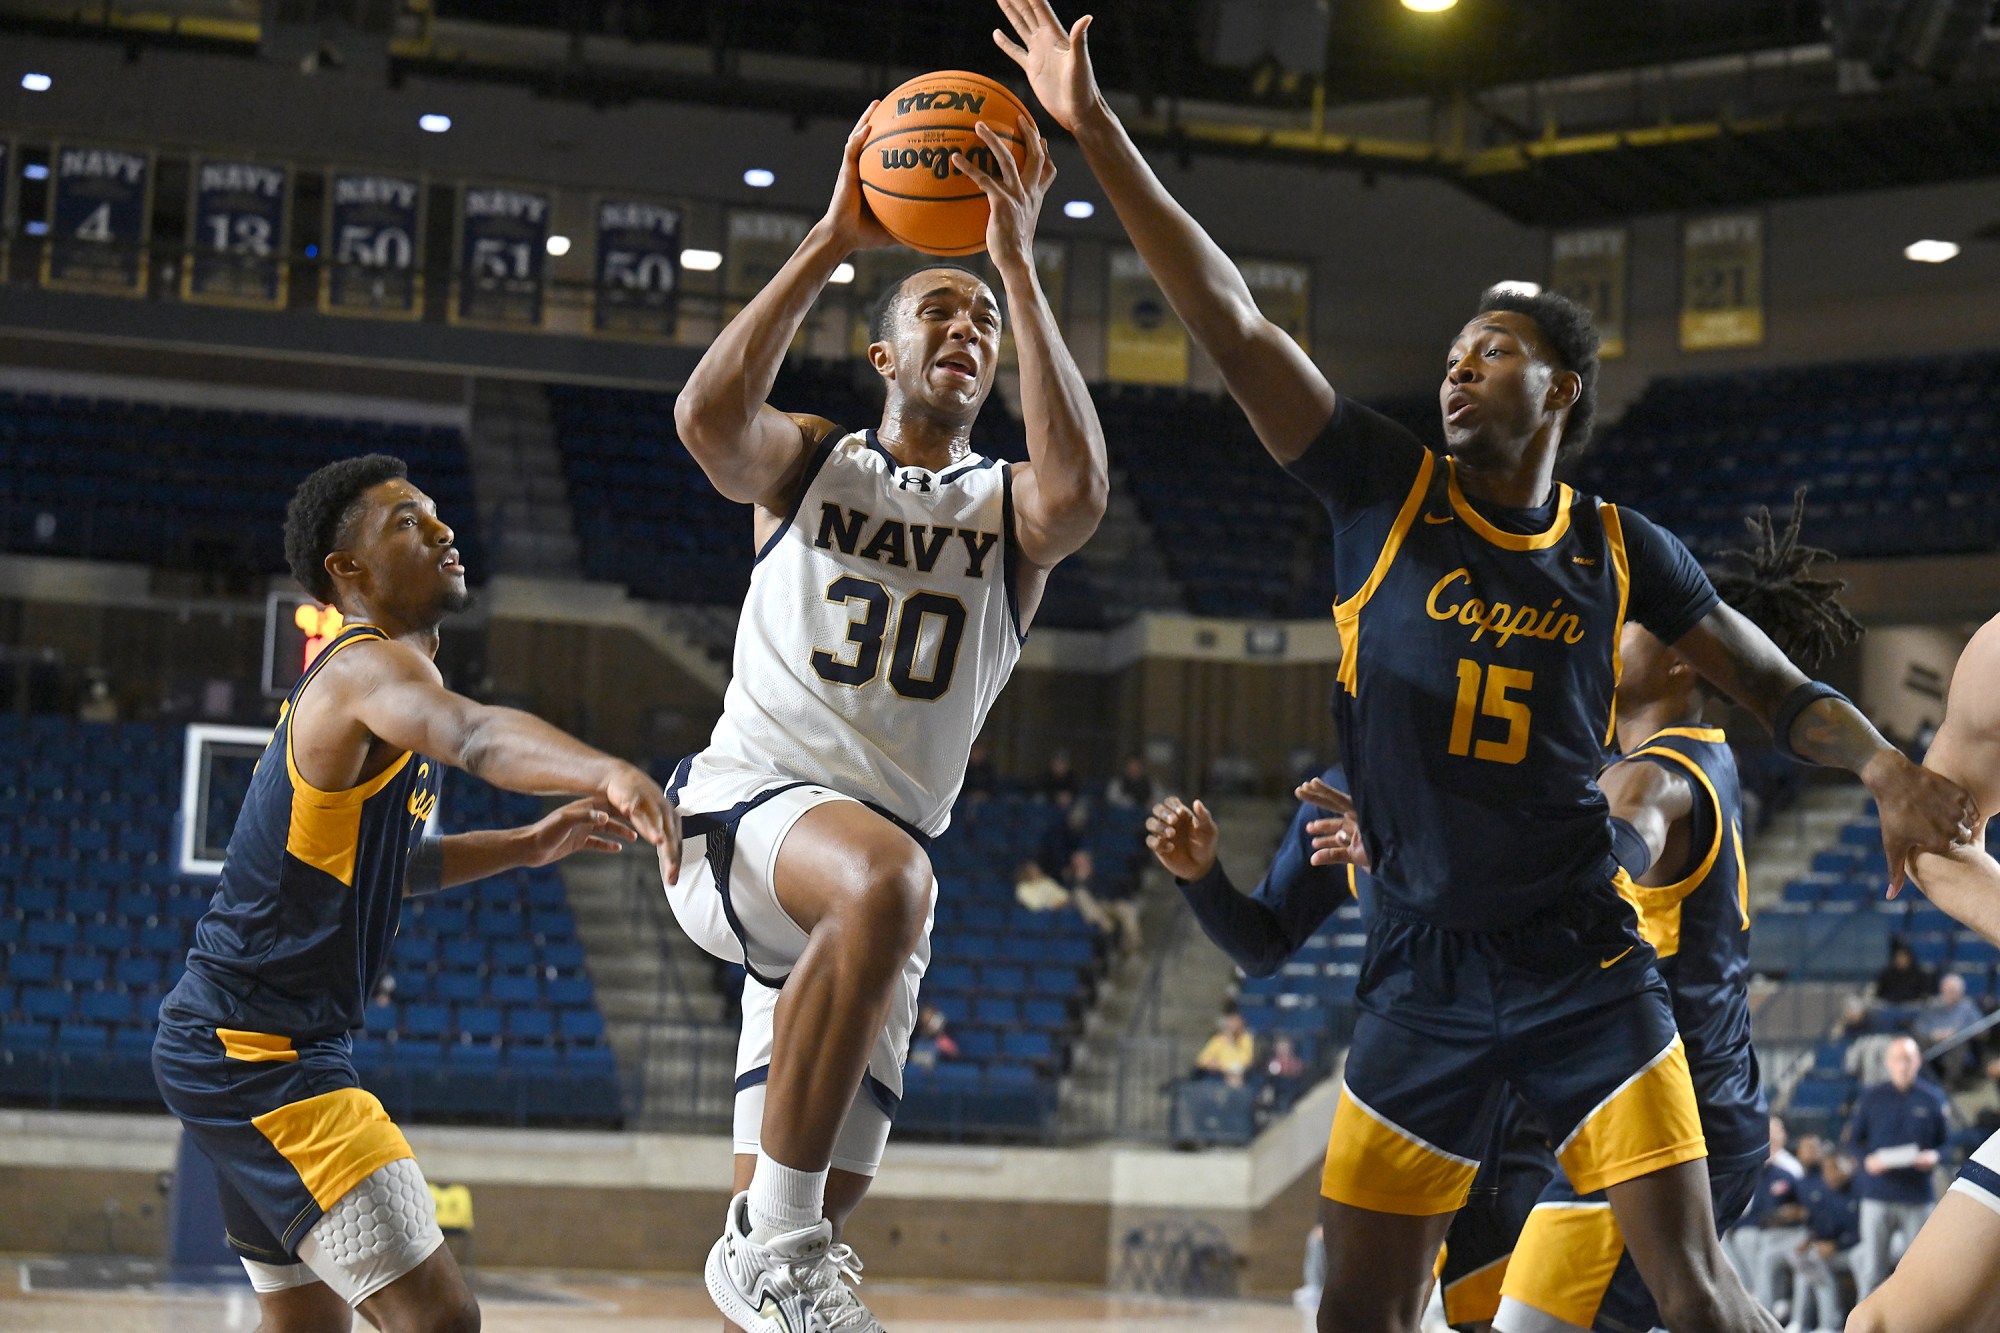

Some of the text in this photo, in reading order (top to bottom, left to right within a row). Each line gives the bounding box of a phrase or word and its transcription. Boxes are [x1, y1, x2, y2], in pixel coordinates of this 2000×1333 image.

[896, 91, 986, 117] NCAA
[62, 151, 145, 183] NAVY
[201, 165, 283, 196] NAVY
[335, 178, 416, 207] NAVY
[466, 191, 546, 222] NAVY
[75, 202, 116, 242] 4
[337, 225, 412, 268] 50
[472, 239, 532, 279] 51
[603, 250, 675, 293] 50
[815, 502, 999, 578] NAVY
[1425, 567, 1585, 648] Coppin
[809, 574, 968, 702] 30
[1448, 658, 1534, 764] 15
